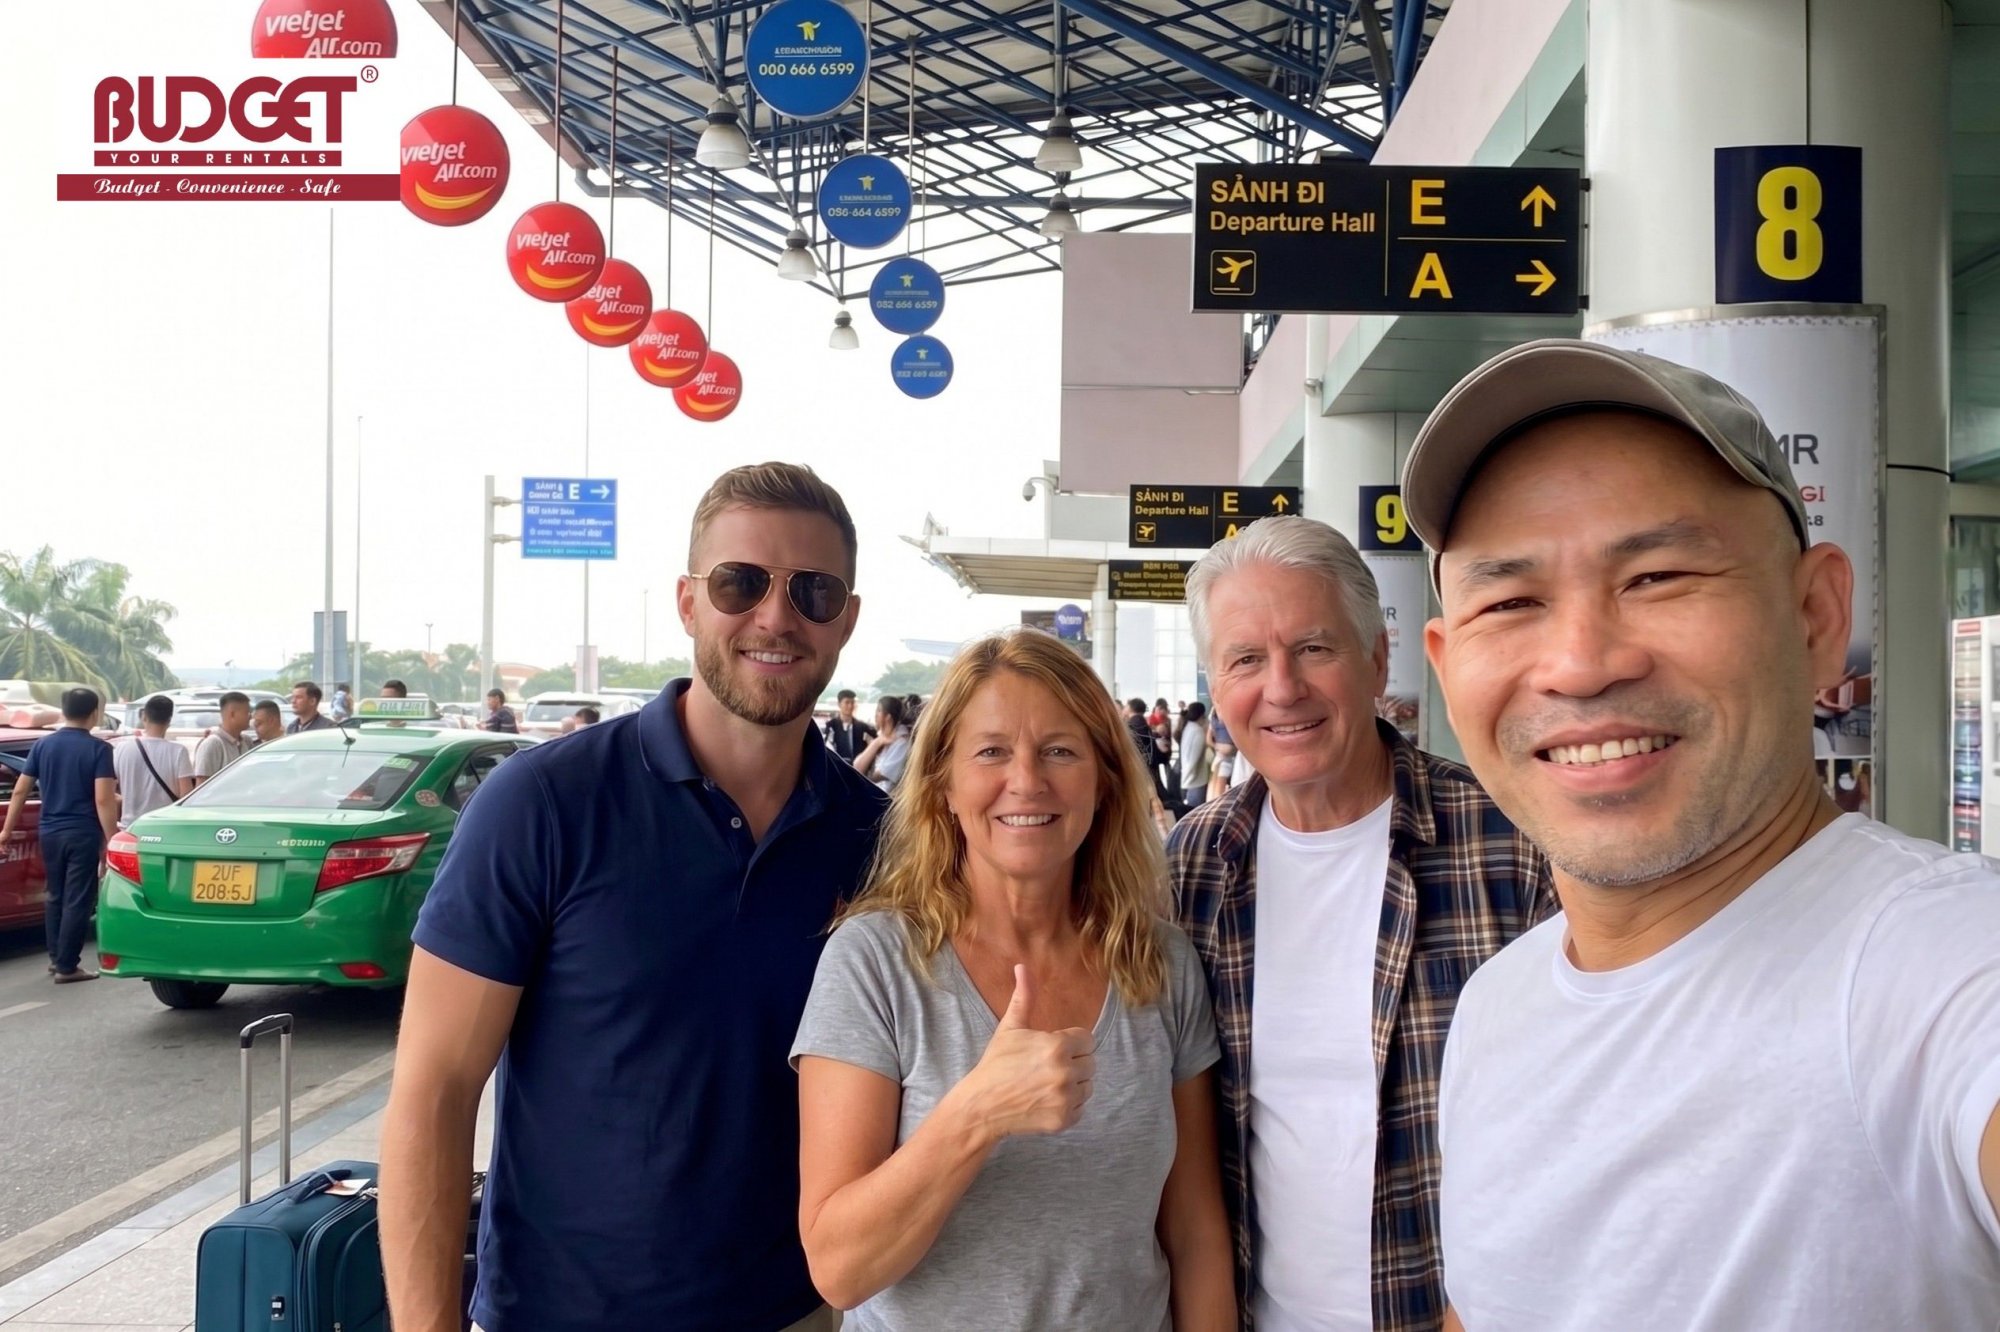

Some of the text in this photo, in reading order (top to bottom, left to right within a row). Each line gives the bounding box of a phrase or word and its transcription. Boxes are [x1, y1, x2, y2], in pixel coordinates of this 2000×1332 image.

[266, 10, 345, 38] vietjet
[759, 63, 855, 76] 000 666 6599
[433, 163, 497, 182] Air.com
[1211, 174, 1324, 203] SẢNH ĐI
[1411, 179, 1446, 225] E
[1210, 211, 1375, 235] Departure Hall
[1756, 166, 1823, 281] 8
[541, 250, 596, 265] Air.com
[1409, 253, 1453, 298] A
[570, 483, 580, 500] E
[1223, 492, 1239, 512] E
[1135, 505, 1208, 516] Departure Hall
[1375, 494, 1407, 544] 9
[1224, 523, 1239, 540] A
